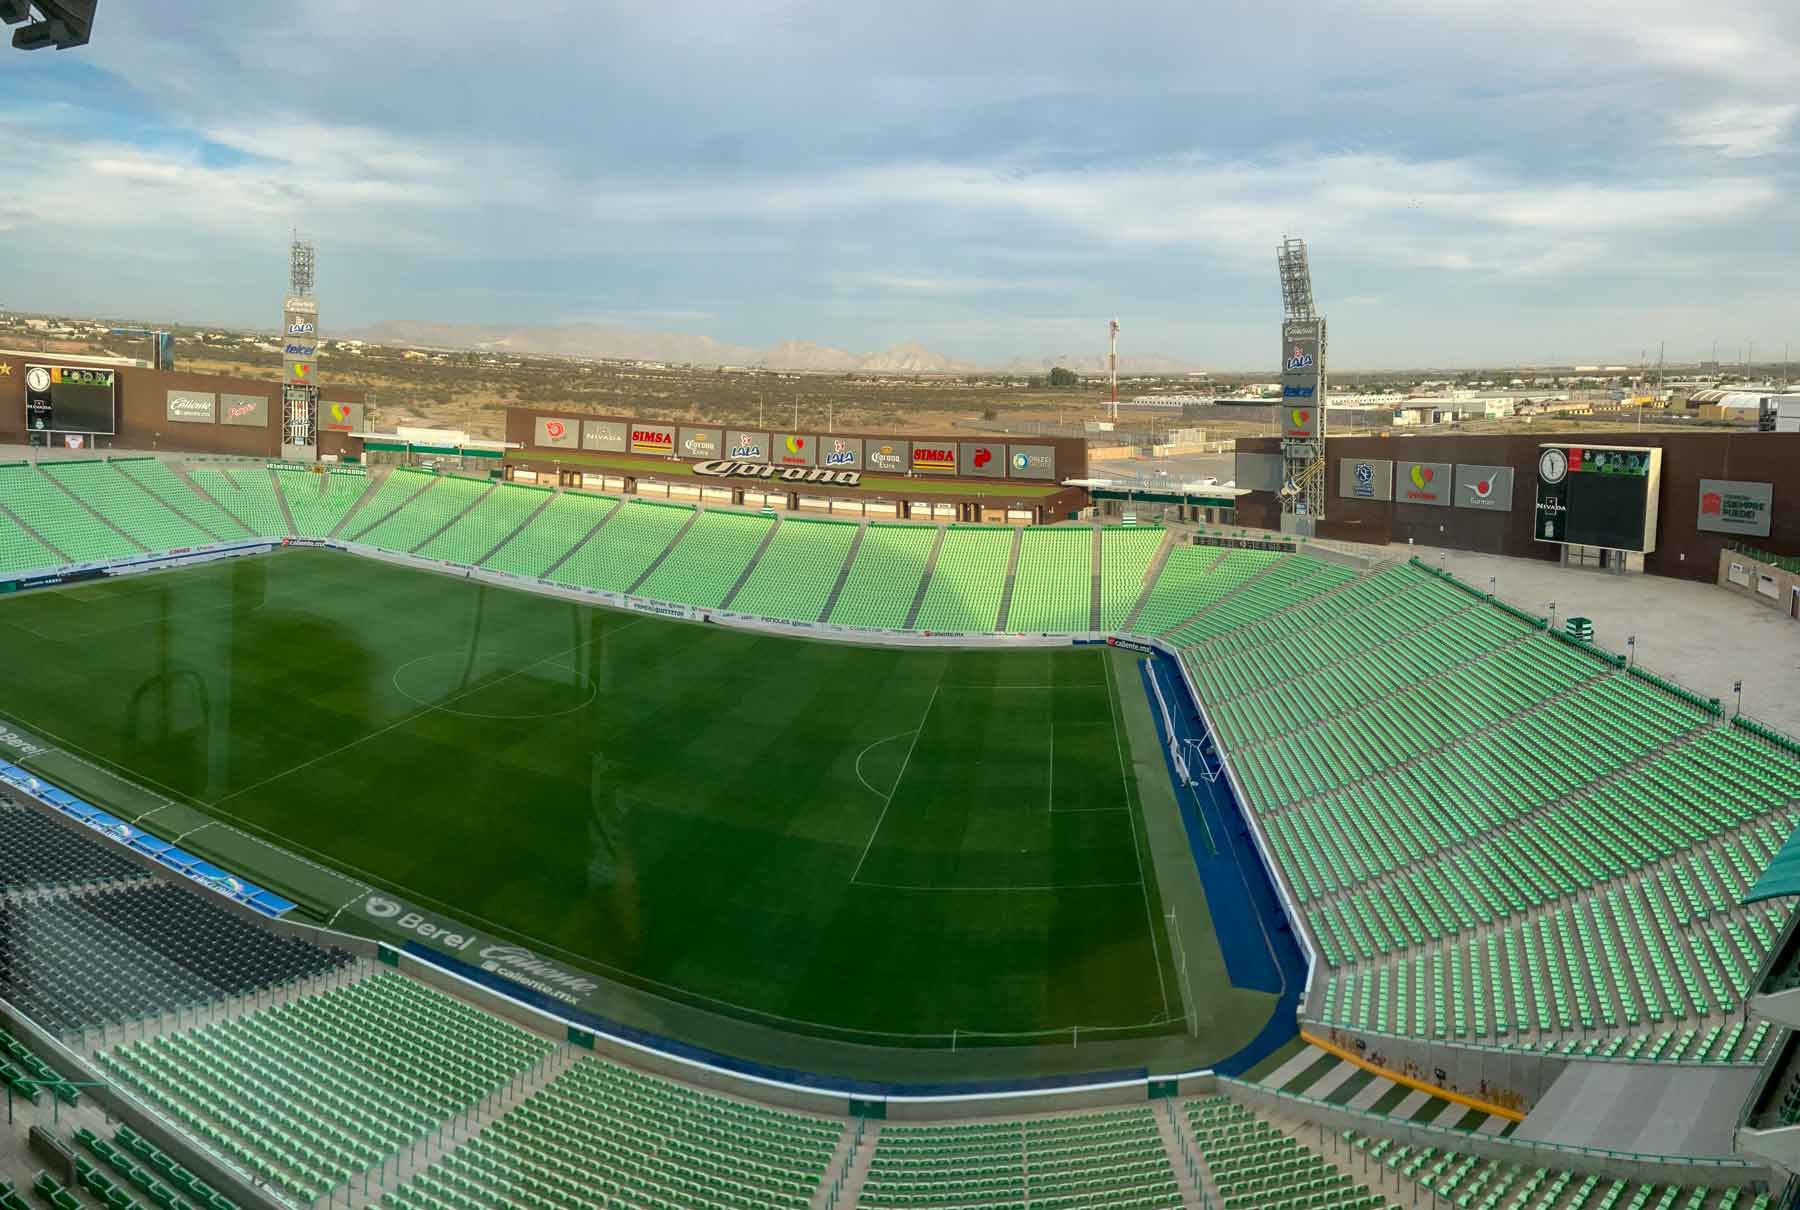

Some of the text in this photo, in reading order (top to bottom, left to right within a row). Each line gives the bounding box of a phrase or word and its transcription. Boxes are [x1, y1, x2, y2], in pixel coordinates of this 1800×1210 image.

[288, 324, 313, 334] LALA
[285, 343, 316, 355] telcel
[1287, 353, 1314, 371] LALA
[170, 397, 212, 411] Caliente
[586, 434, 623, 442] NIVADA
[632, 431, 673, 444] SIMSA
[685, 439, 715, 450] Corona
[731, 446, 761, 459] LALA
[826, 452, 856, 466] LALA
[871, 451, 902, 463] Corona
[914, 449, 954, 462] SIMSA
[692, 459, 862, 487] Corona
[1537, 503, 1567, 512] NIVADA
[397, 912, 476, 951] Berel
[497, 966, 580, 1005] caliente.mx
